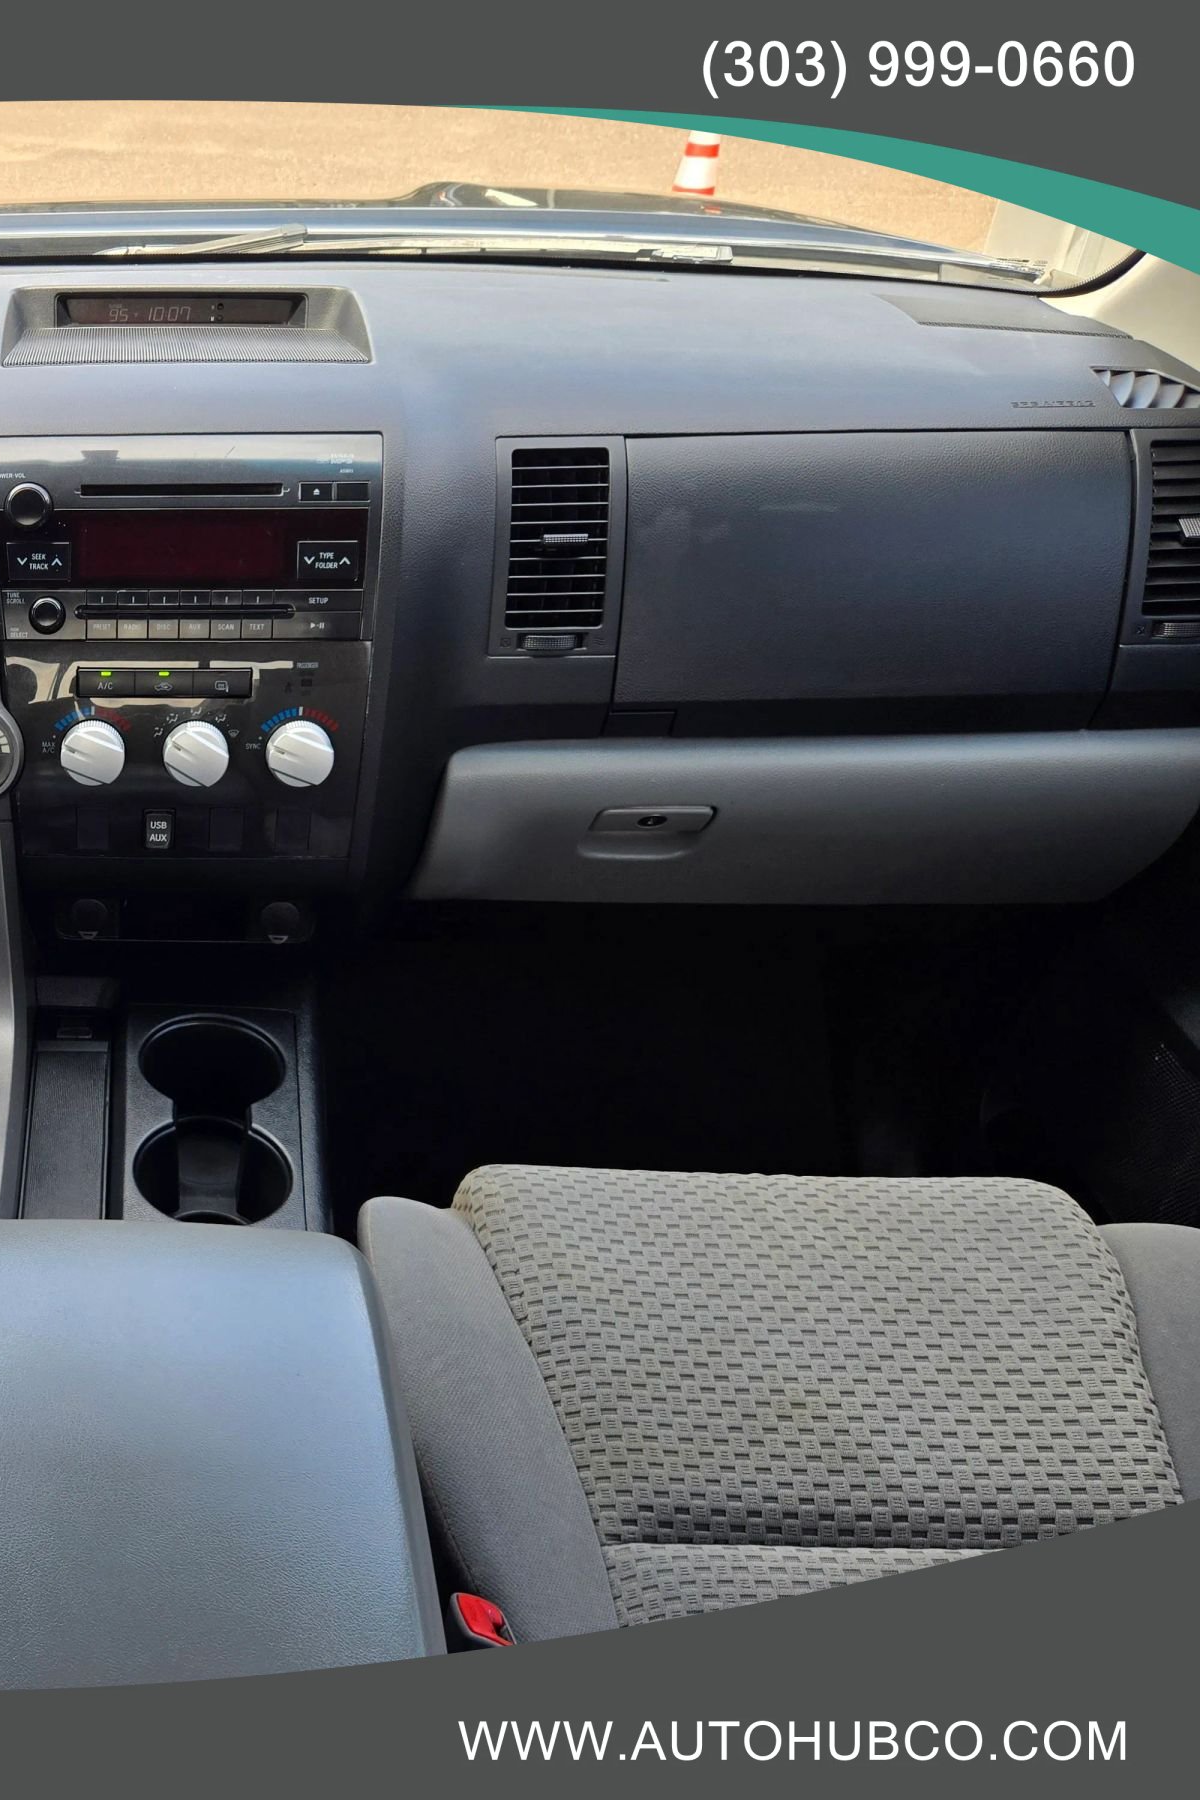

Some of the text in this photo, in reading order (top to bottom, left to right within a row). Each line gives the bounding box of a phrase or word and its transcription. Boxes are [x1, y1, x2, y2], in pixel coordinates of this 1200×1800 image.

[319, 552, 335, 560] TYPE
[29, 562, 49, 570] TRACK
[217, 623, 235, 631] SCAN
[249, 623, 265, 631] TEXT
[97, 682, 113, 690] A/C
[150, 821, 168, 829] USB
[149, 833, 168, 842] AUX
